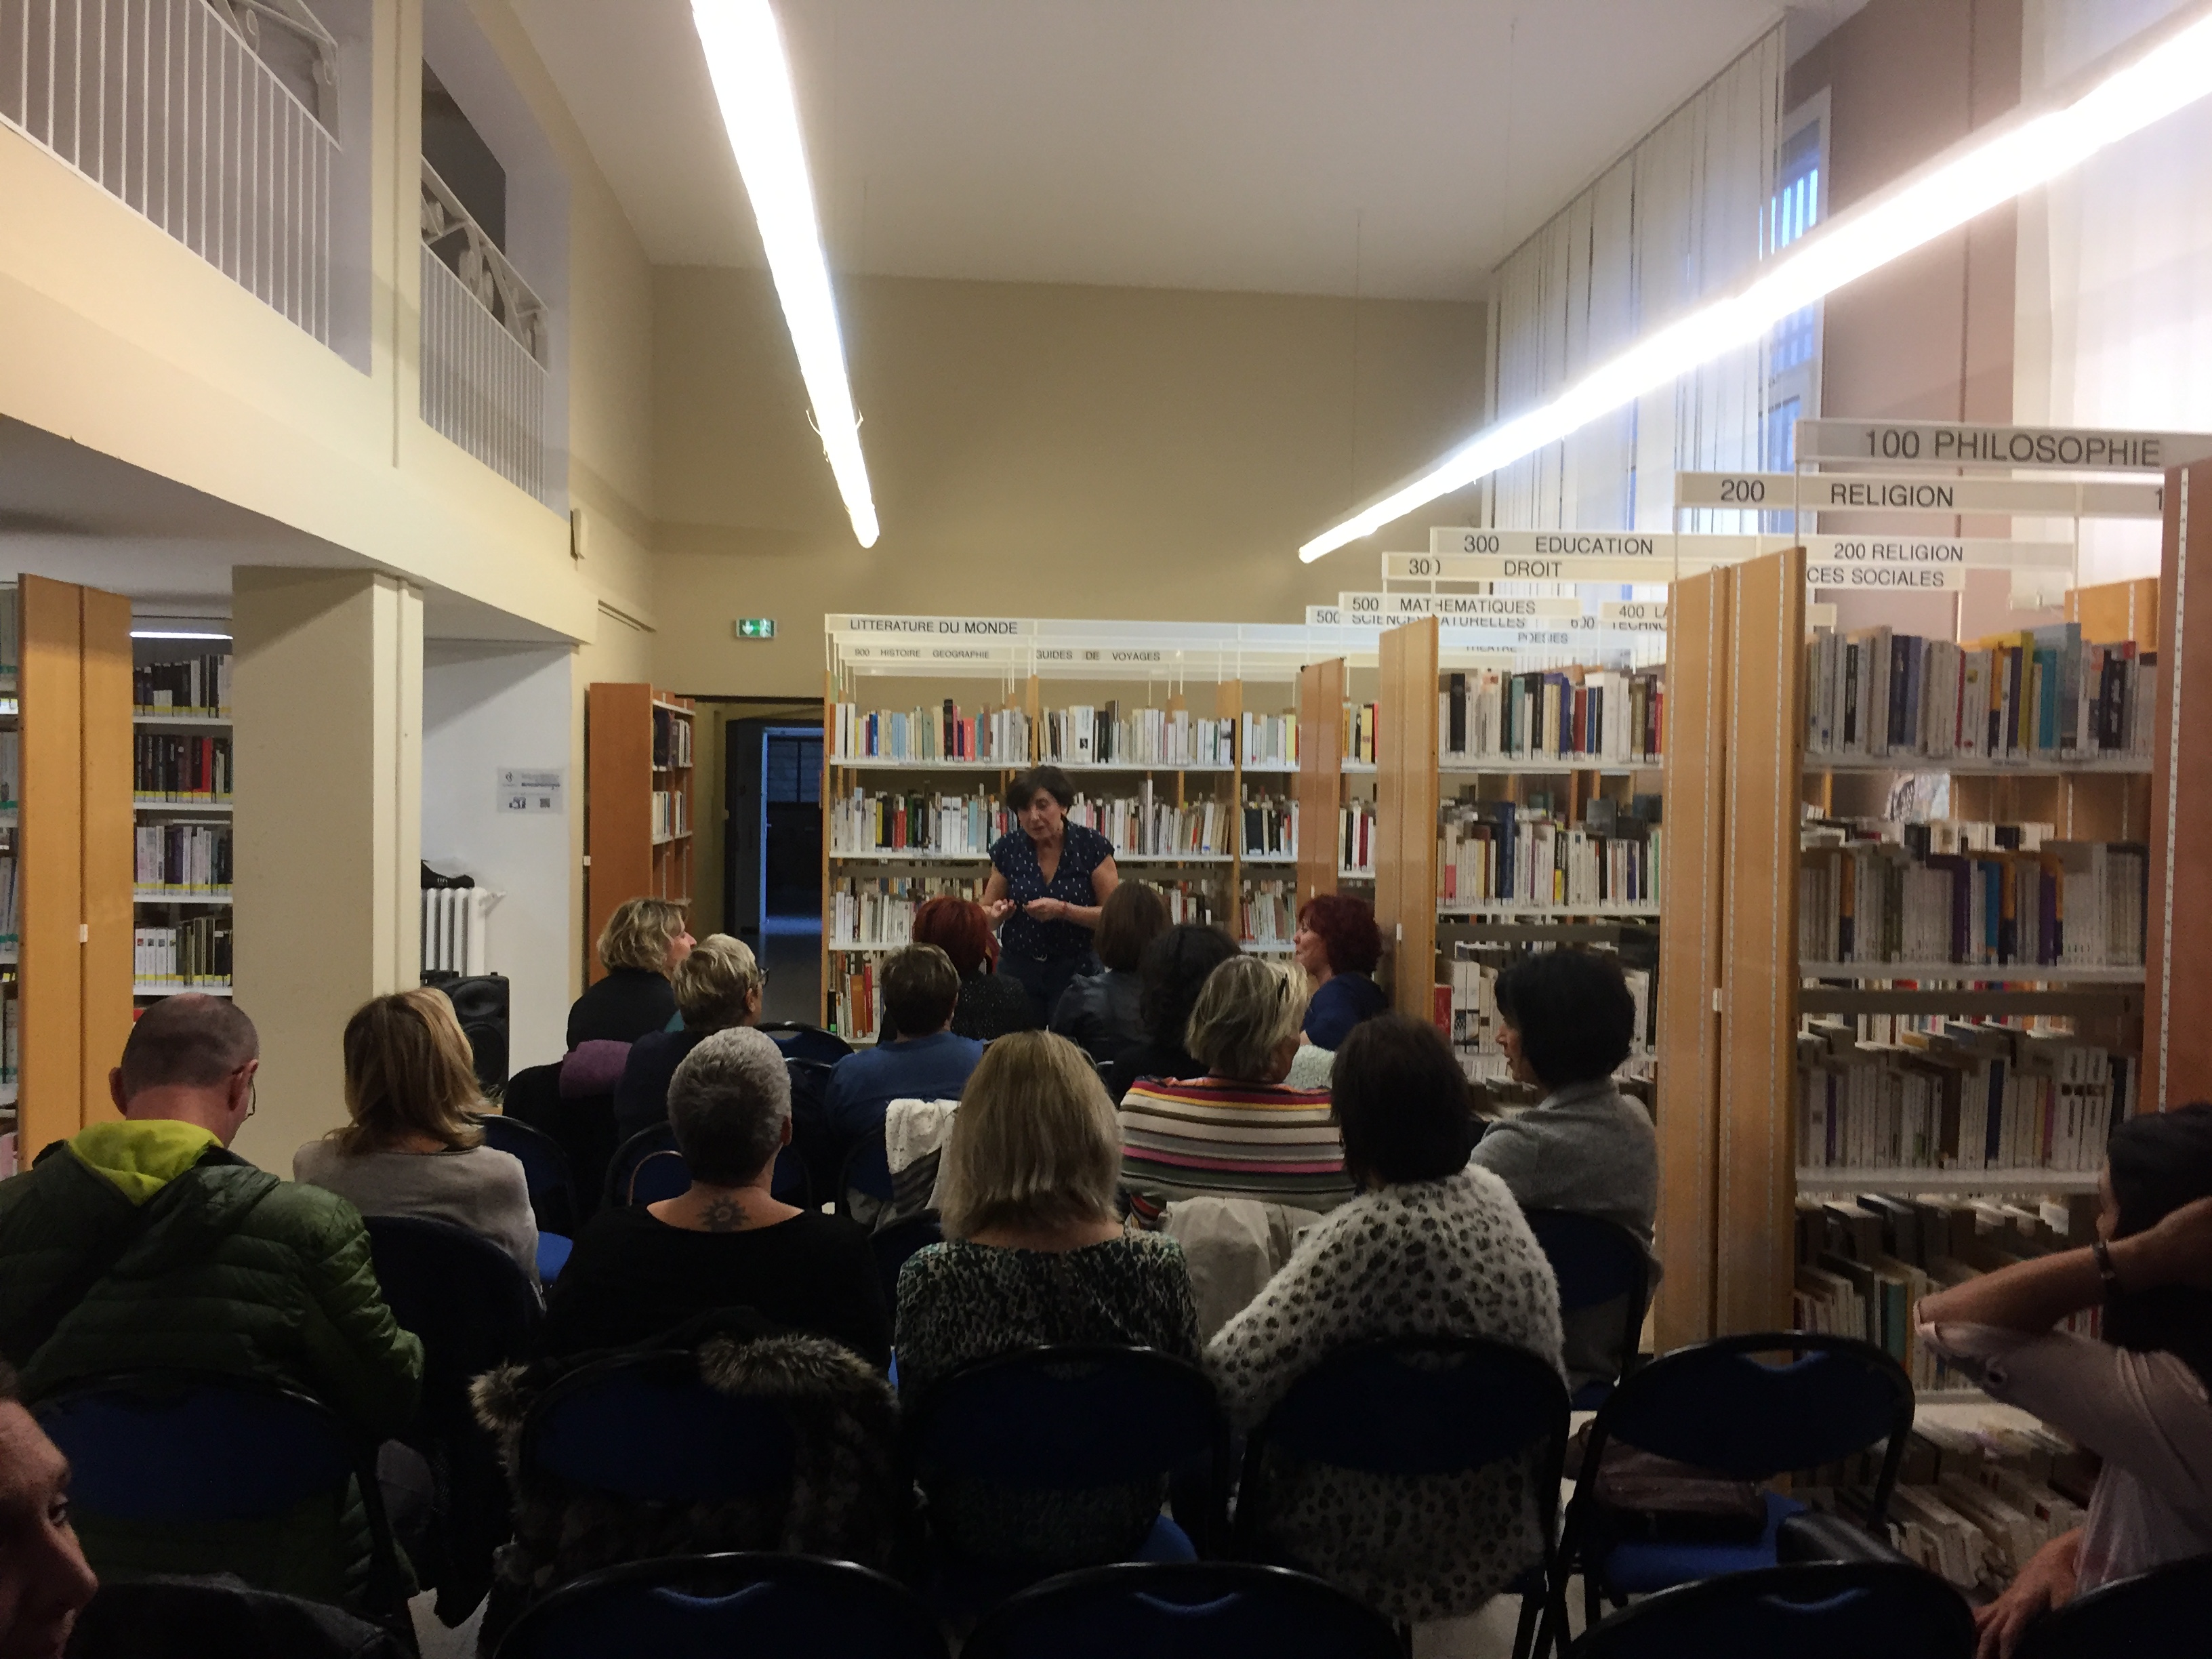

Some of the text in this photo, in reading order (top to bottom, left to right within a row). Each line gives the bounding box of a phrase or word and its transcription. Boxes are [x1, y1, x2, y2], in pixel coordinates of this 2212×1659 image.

[1866, 430, 2160, 467] 100 PHILOSOPHIE
[1720, 479, 1954, 508] 200 RELIGION
[1464, 534, 1654, 556] 300 EDUCATION
[1834, 542, 1963, 562] 200 RELIGION
[1504, 560, 1562, 577] DROIT
[1851, 567, 1944, 588] SOCIALES
[1352, 596, 1536, 615] 500 MATHEMATIQUES
[1619, 604, 1645, 619] 400
[850, 619, 1018, 635] LITTERATURE DU MONDE
[855, 648, 870, 657] 900
[880, 648, 921, 658] HISTOIRE
[933, 649, 990, 659] GEOGRAPHIE
[1085, 651, 1100, 661] DE
[1111, 651, 1161, 661] VOYAGES
